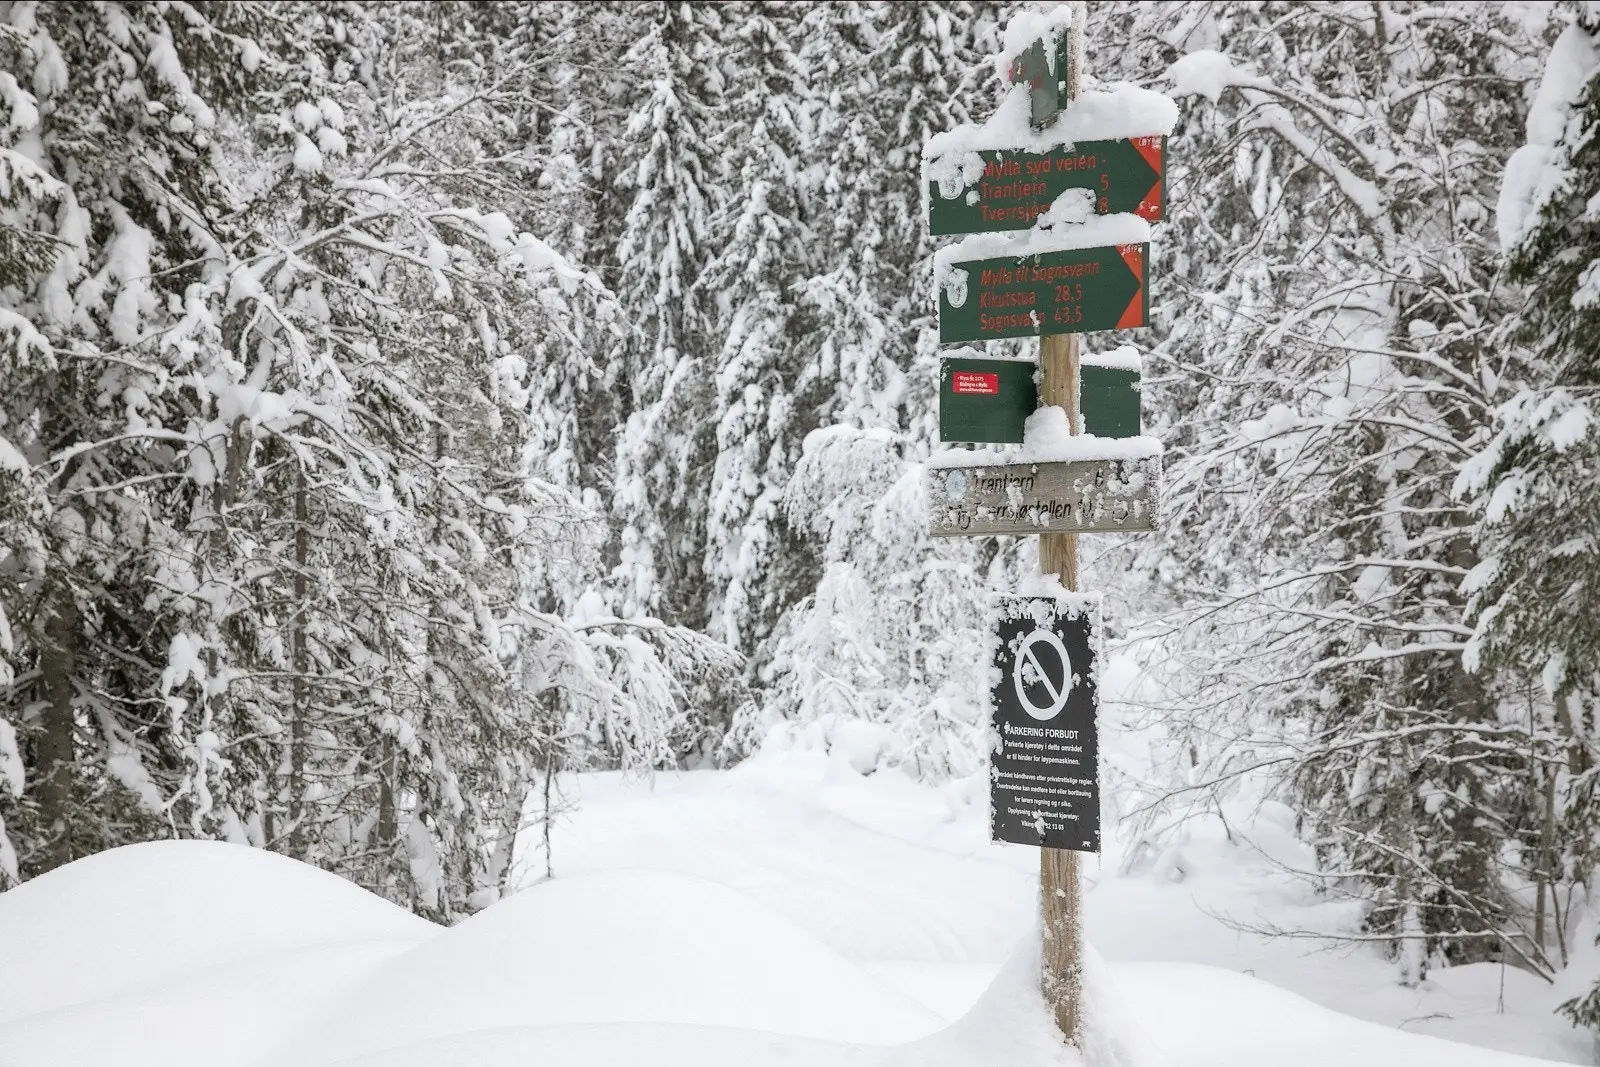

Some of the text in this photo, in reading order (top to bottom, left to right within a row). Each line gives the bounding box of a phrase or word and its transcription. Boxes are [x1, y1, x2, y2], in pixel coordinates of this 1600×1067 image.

[984, 160, 1021, 180] Mylla
[1026, 157, 1051, 179] syd
[1055, 154, 1096, 172] veien
[981, 173, 1110, 202] Trantjern 5
[980, 195, 1109, 223] Tverrsjøs 8
[980, 260, 1100, 288] Mylla til Sognsvann
[979, 290, 1037, 309] Kikutstua
[980, 311, 1046, 333] Sognsvan
[973, 499, 1072, 525] Terrsjøstallen
[1004, 725, 1079, 740] ARKERING FORBUDT
[1004, 740, 1024, 749] Parkerte
[1024, 741, 1044, 752] kjøretøy
[1047, 743, 1061, 752] dette
[1061, 744, 1083, 753] området
[1017, 753, 1033, 762] hinder
[1033, 754, 1041, 762] for
[1041, 755, 1081, 765] løypemaskinen.
[997, 771, 1014, 779] mrådet
[996, 782, 1022, 791] Overtredelse
[1022, 784, 1031, 792] kan
[1030, 785, 1048, 794] medføre
[1048, 786, 1057, 794] bot
[1057, 787, 1068, 795] eller
[1033, 797, 1051, 807] regning
[1050, 800, 1058, 808] og
[1007, 806, 1031, 817] Opplysning
